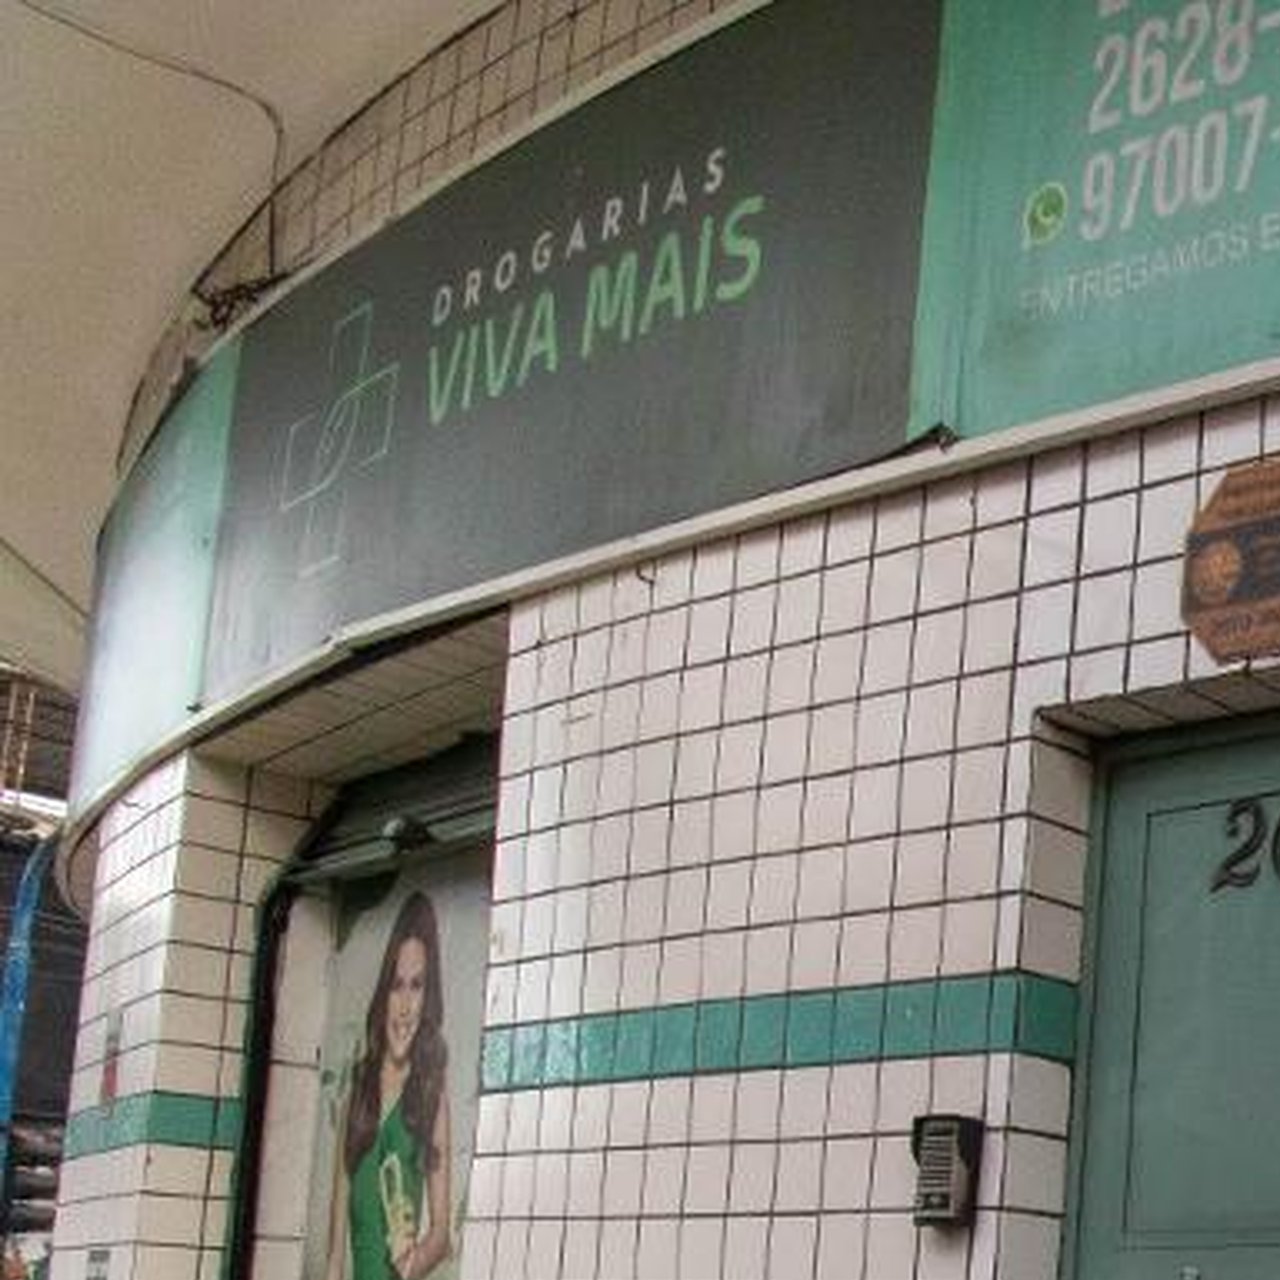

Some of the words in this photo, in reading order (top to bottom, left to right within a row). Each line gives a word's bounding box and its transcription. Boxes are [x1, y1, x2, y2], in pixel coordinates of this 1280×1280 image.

[428, 291, 557, 425] VIVA
[581, 196, 765, 358] MAIS
[432, 148, 725, 327] DROGARIAS
[1021, 222, 1249, 321] ENTREGAMOS
